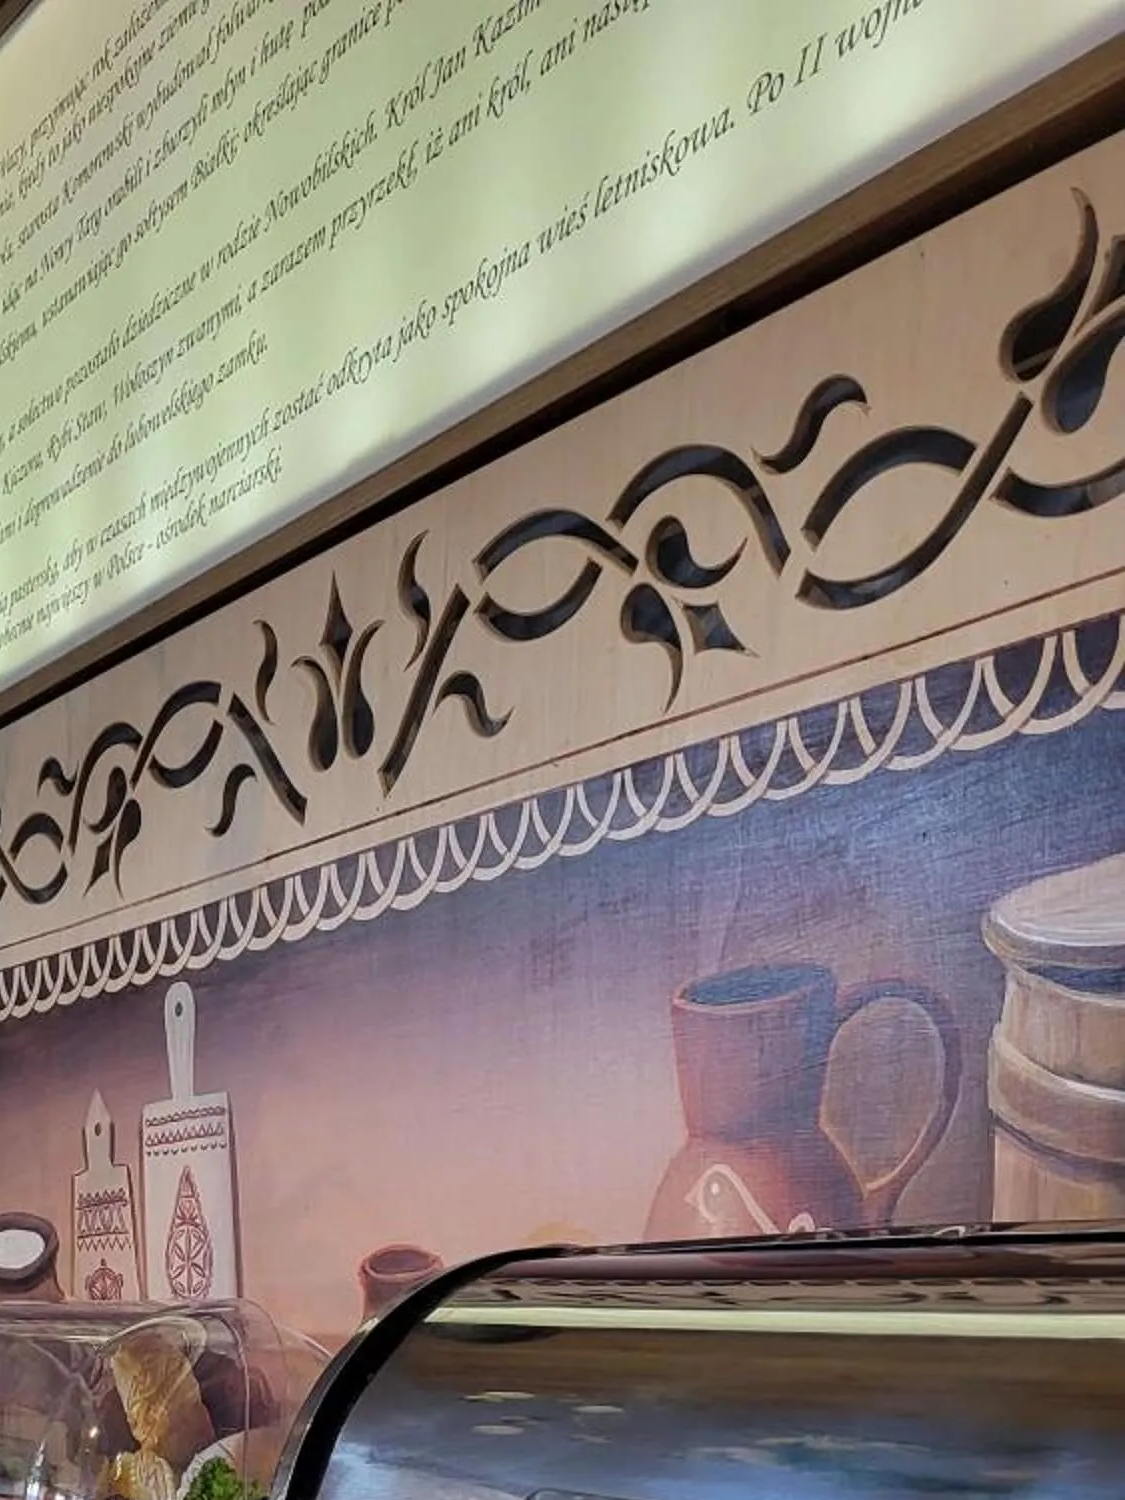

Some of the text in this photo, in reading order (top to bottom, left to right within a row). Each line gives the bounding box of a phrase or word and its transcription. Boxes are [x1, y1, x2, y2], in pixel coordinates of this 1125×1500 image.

[321, 2, 381, 84] granice
[426, 128, 443, 164] iż
[449, 93, 481, 146] ani
[540, 18, 577, 76] ani
[217, 215, 261, 269] rodzie
[385, 62, 431, 128] Król
[429, 46, 466, 98] Jan
[273, 374, 323, 431] zostać
[327, 336, 392, 395] odkryta
[392, 300, 436, 363] jako
[442, 242, 530, 326] spokojna
[537, 192, 589, 254] wieś
[595, 108, 734, 218] letniskowa.
[747, 72, 784, 114] Po
[217, 330, 267, 384] zamku.
